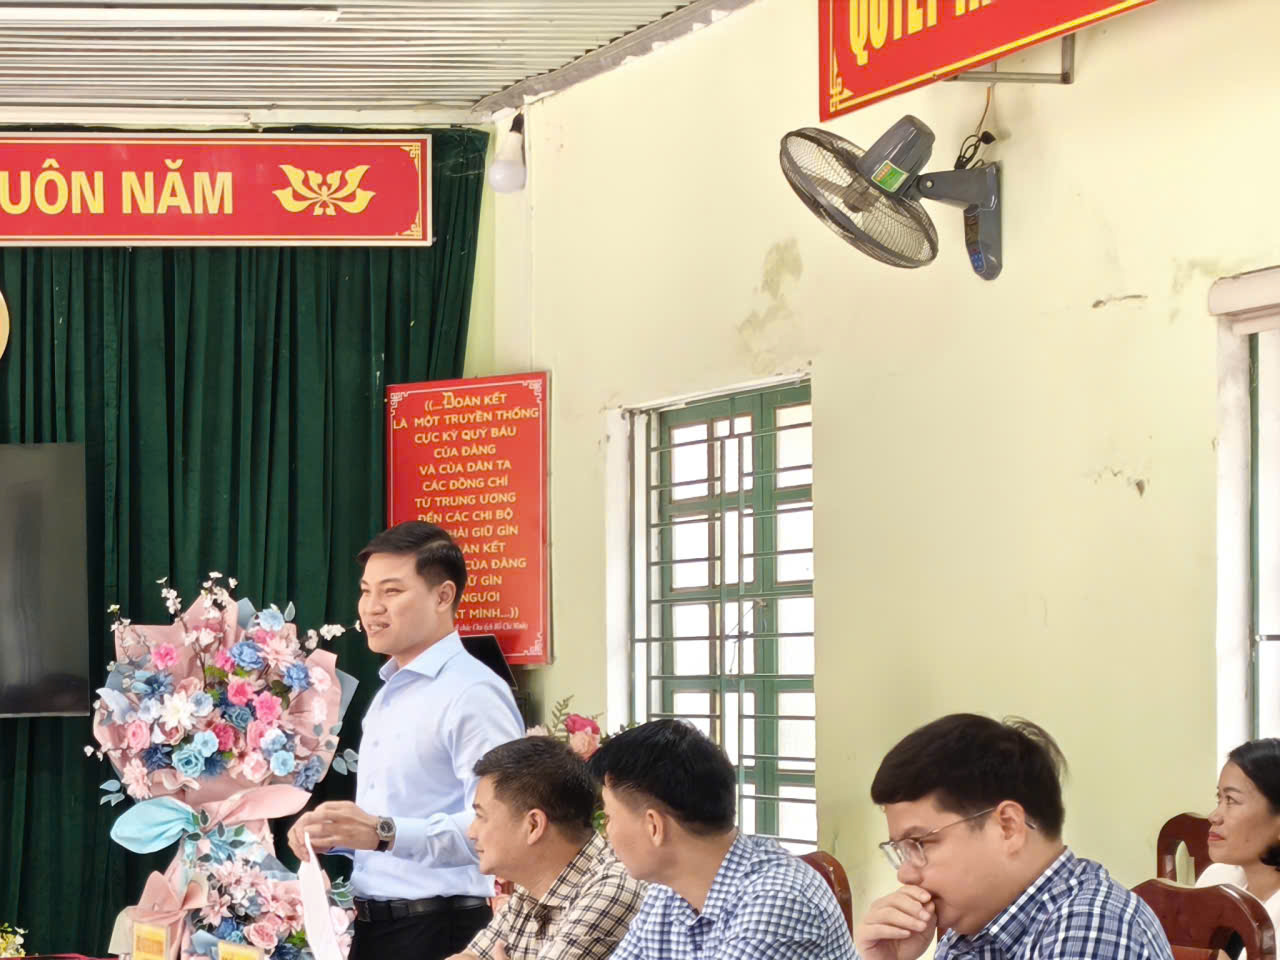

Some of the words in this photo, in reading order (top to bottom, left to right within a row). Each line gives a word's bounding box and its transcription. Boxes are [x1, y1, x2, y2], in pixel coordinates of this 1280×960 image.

[121, 158, 233, 215] NĂM
[484, 392, 507, 406] KẾT
[444, 410, 492, 425] TRUYỀN
[496, 406, 539, 420] THỐNG
[490, 425, 517, 438] BÁU
[434, 446, 459, 459] CỦA
[461, 443, 496, 457] ĐẢNG
[419, 464, 436, 475] VÀ
[439, 462, 464, 474] CỦA
[496, 459, 512, 470] TA
[423, 479, 447, 491] CÁC
[449, 477, 484, 490] ĐỒNG
[488, 474, 508, 487] CHÍ
[435, 495, 476, 507] TRUNG
[445, 510, 469, 522] CÁC
[472, 511, 493, 521] CHI
[491, 556, 527, 569] ĐẢNG
